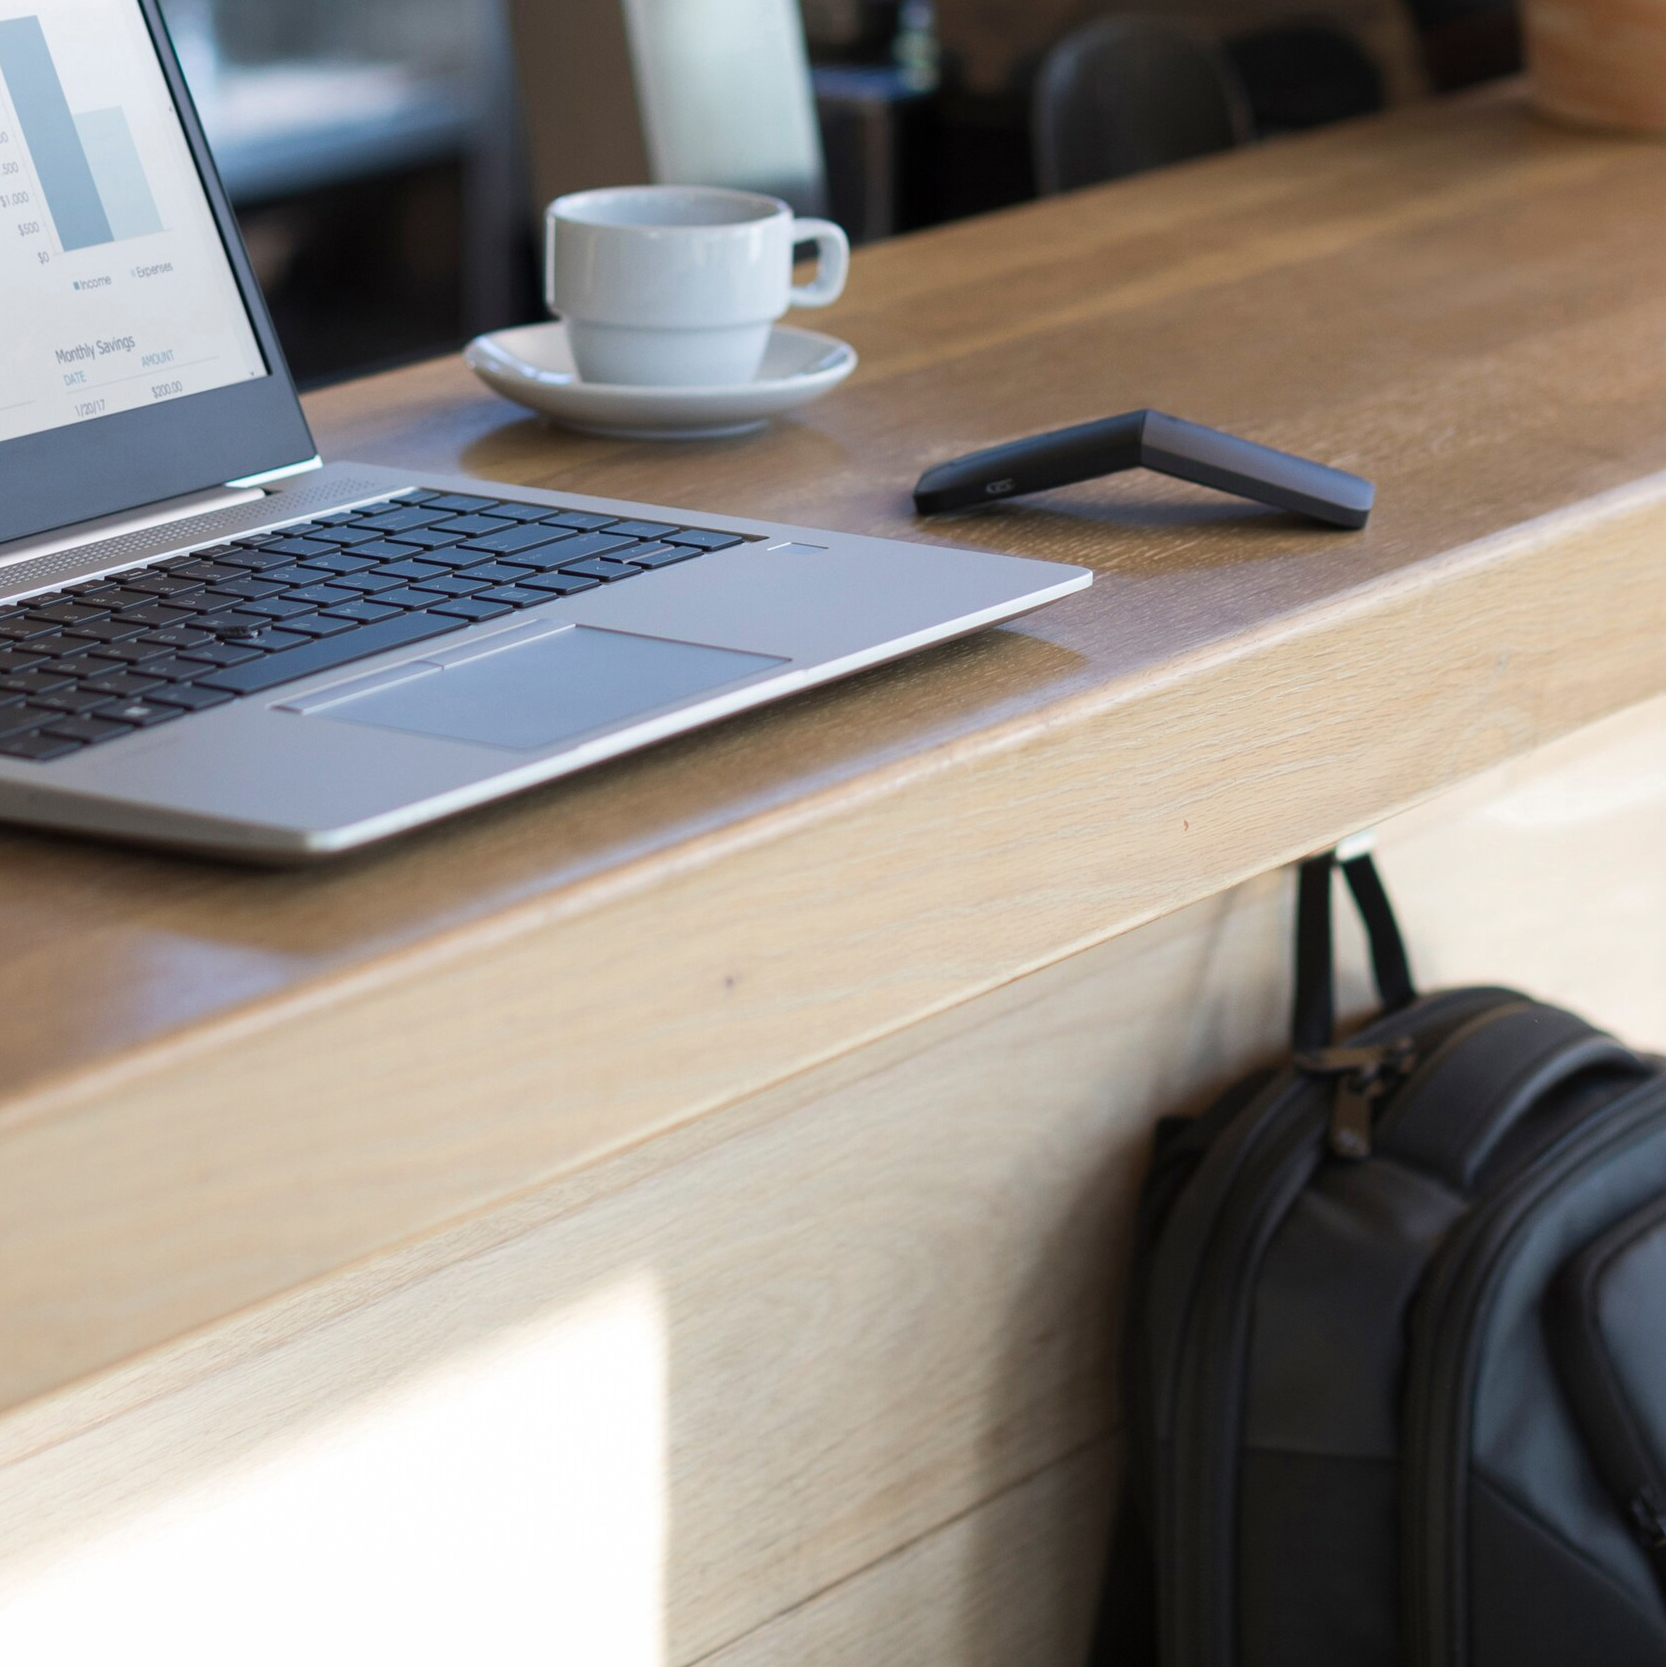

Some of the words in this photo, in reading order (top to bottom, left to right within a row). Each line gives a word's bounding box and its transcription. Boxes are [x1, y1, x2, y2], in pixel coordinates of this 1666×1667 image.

[17, 221, 41, 238] $500
[37, 251, 50, 265] $0
[135, 261, 174, 279] Expenses
[79, 274, 113, 291] Income
[55, 340, 96, 365] Monthly
[96, 335, 136, 356] Savings
[63, 370, 88, 387] DATE
[141, 349, 176, 368] AMOUNT
[74, 398, 106, 417] 1/20/17
[151, 380, 184, 399] $200.00
